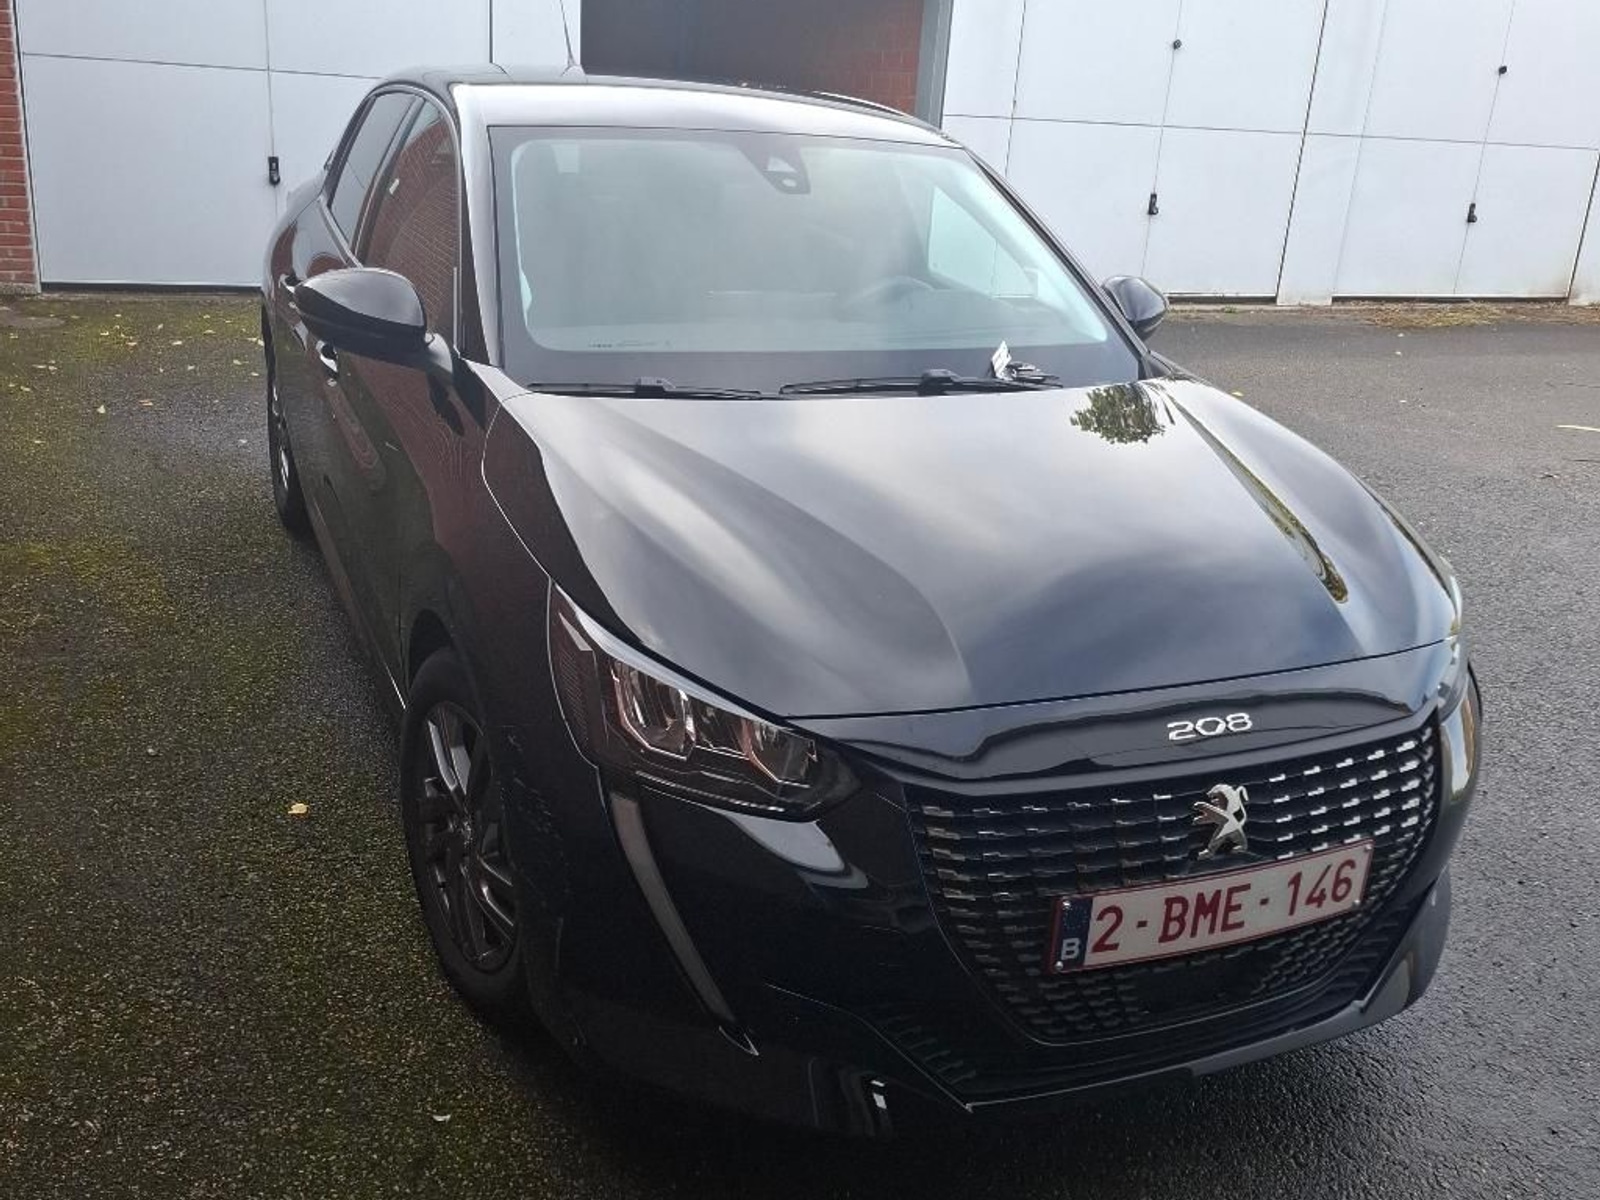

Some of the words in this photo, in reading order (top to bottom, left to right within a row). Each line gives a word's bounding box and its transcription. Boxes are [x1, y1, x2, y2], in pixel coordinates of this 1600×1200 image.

[1167, 712, 1253, 740] 208
[1091, 859, 1357, 953] 2-BME-146
[1061, 938, 1081, 960] B
